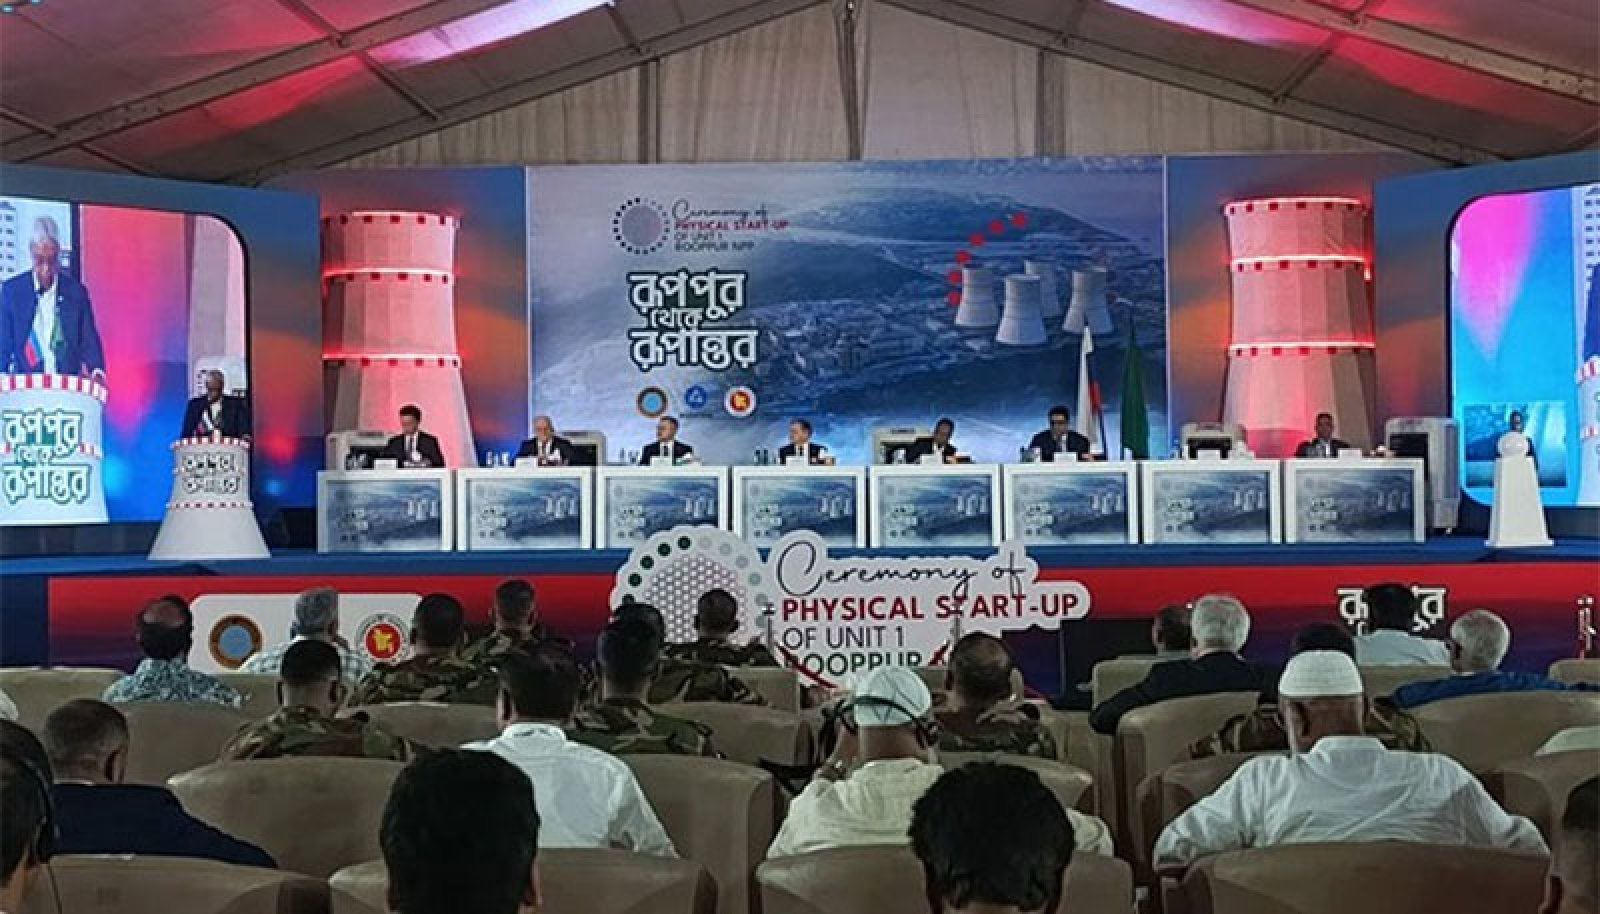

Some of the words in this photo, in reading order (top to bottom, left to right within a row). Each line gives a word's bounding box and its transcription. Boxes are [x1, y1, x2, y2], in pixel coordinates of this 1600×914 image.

[628, 268, 747, 319] রূপপুর
[629, 329, 760, 370] রূপান্তর
[3, 410, 82, 455] রূপপুর
[776, 540, 978, 598] Ceremony
[992, 551, 1027, 598] of
[783, 597, 925, 621] PHYSICAL
[783, 627, 817, 650] OF
[825, 626, 886, 649] UNIT
[895, 626, 905, 648] 1
[785, 651, 922, 676] OOPPUR
